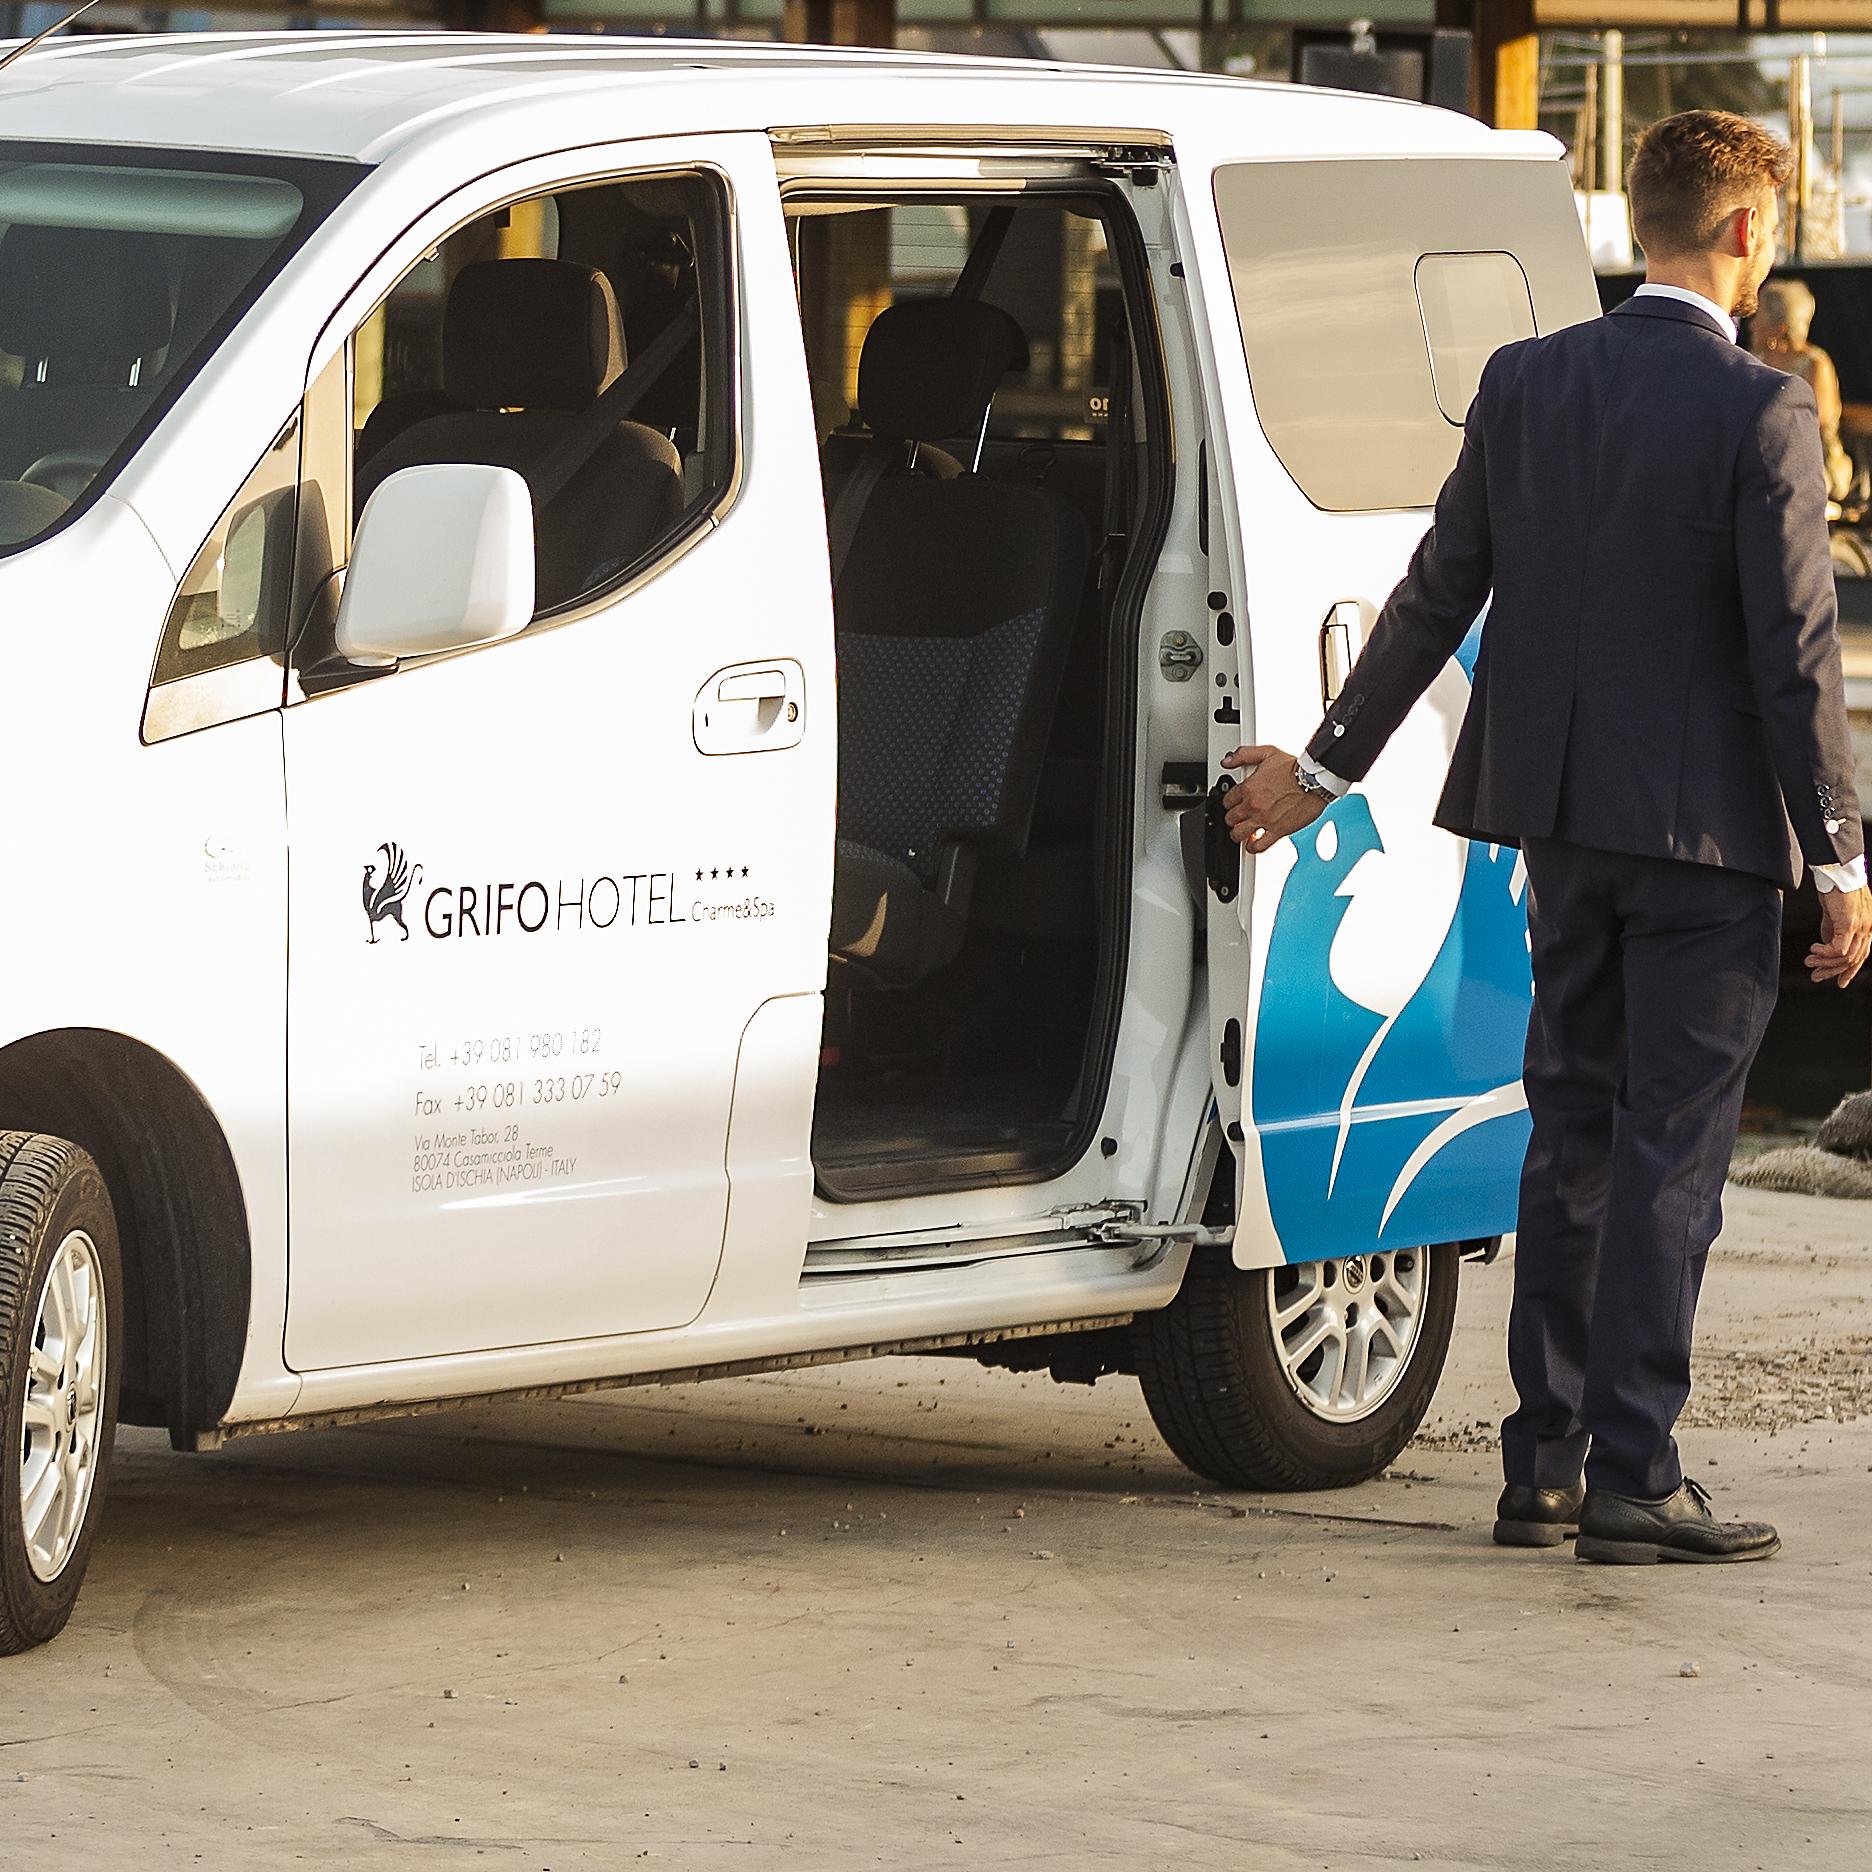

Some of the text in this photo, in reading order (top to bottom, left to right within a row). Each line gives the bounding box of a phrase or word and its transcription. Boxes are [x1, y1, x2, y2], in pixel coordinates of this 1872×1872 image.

[490, 1036, 521, 1063] 081
[530, 1032, 563, 1059] 980
[571, 1028, 601, 1054] 182
[415, 1071, 623, 1117] Fax +39 081 333 07 59
[414, 1134, 430, 1152] Via
[433, 1132, 467, 1150] Monte
[504, 1125, 519, 1143] 28
[412, 1174, 443, 1193] ISOLA
[550, 1157, 578, 1176] ITALY
[413, 1143, 555, 1173] 80074 Casamicciola Terme
